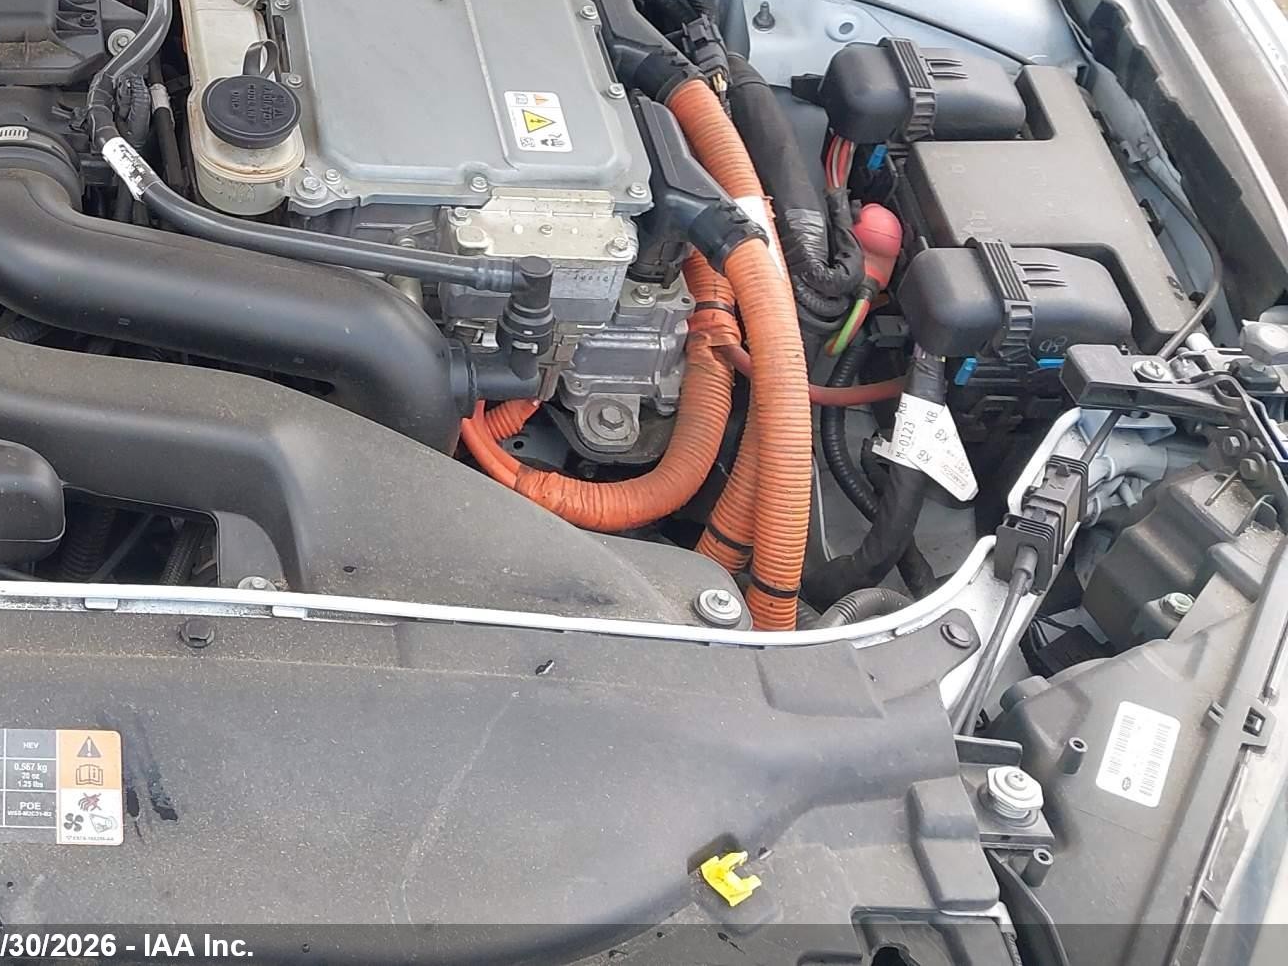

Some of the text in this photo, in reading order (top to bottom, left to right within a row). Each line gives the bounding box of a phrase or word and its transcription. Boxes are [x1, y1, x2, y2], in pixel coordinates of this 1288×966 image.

[37, 762, 48, 773] kg
[32, 780, 44, 788] lbs
[19, 801, 42, 810] POE
